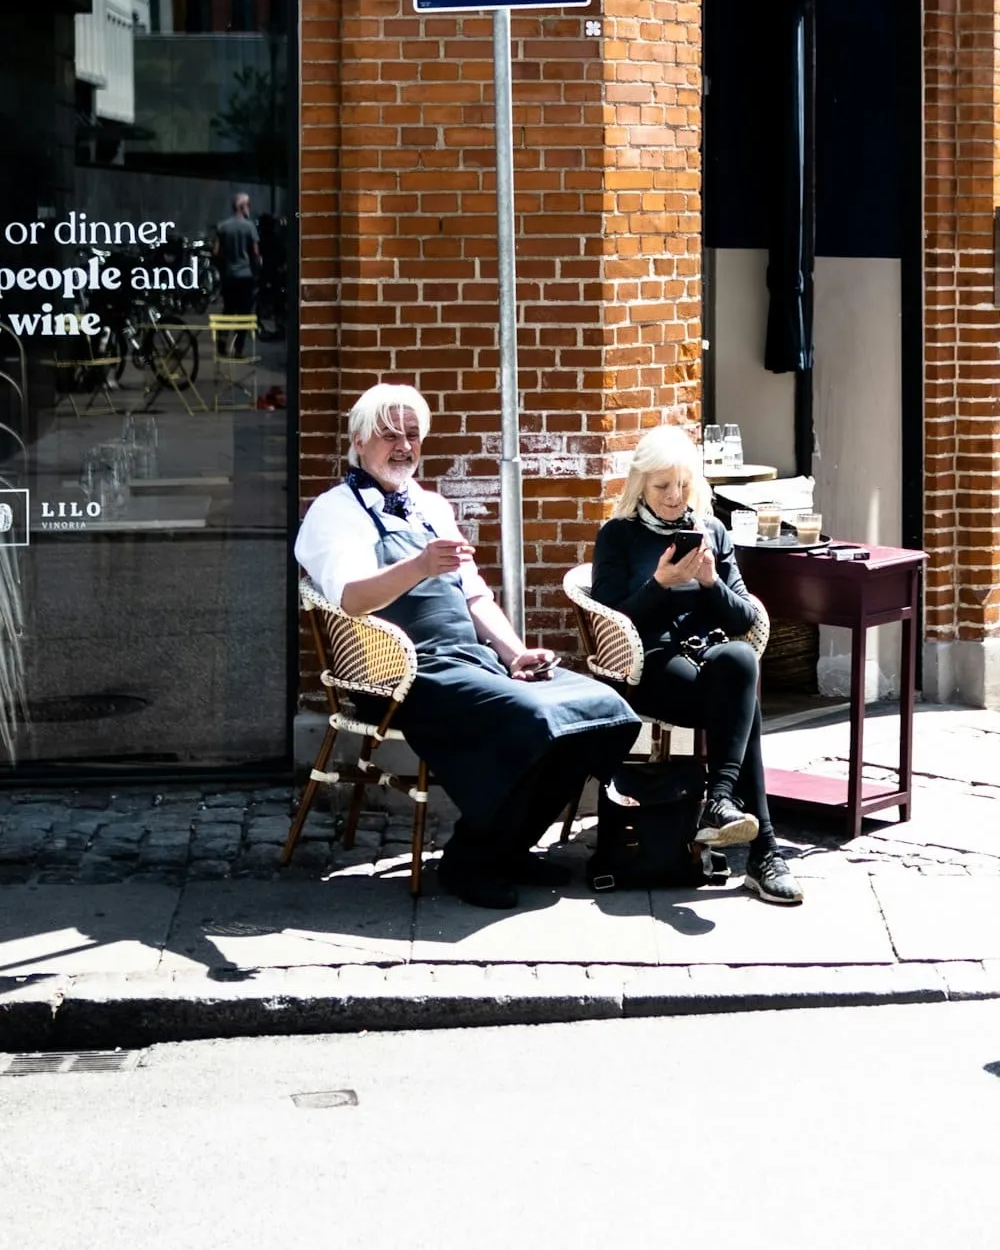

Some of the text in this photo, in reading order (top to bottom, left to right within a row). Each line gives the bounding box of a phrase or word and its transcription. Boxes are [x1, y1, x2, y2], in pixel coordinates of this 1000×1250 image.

[5, 210, 176, 245] or dinner
[0, 255, 200, 298] people and
[8, 302, 101, 336] wine
[41, 501, 101, 517] LILO
